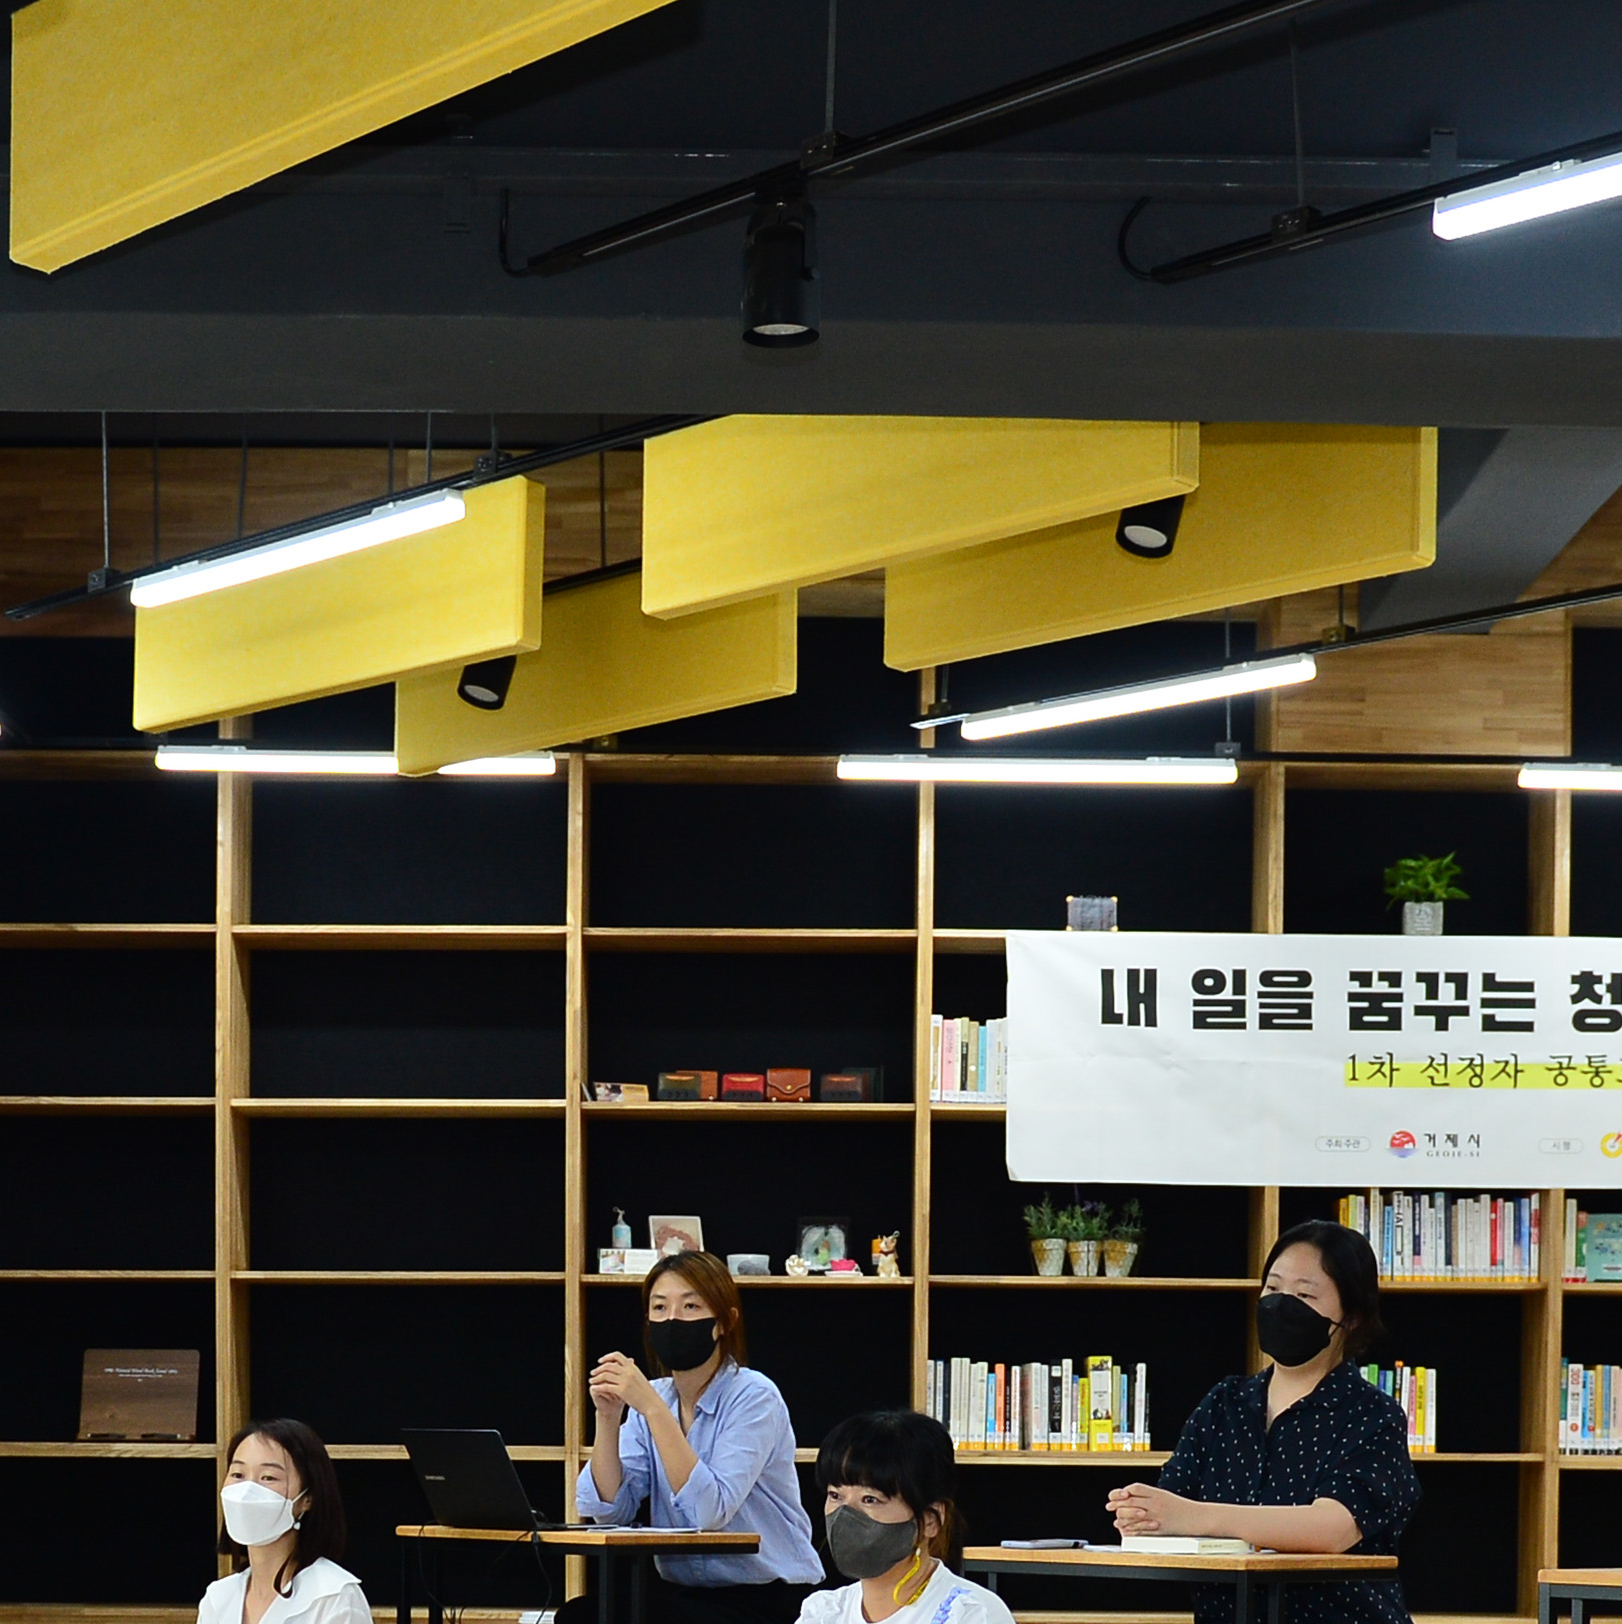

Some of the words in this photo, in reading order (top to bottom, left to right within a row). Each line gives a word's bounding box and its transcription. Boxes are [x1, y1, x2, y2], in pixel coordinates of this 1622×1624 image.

[1100, 967, 1158, 1028] 내
[1190, 967, 1315, 1031] 일을
[1346, 970, 1537, 1033] 꿈꾸는
[1346, 1051, 1401, 1089] 1차
[1419, 1052, 1526, 1089] 선정자
